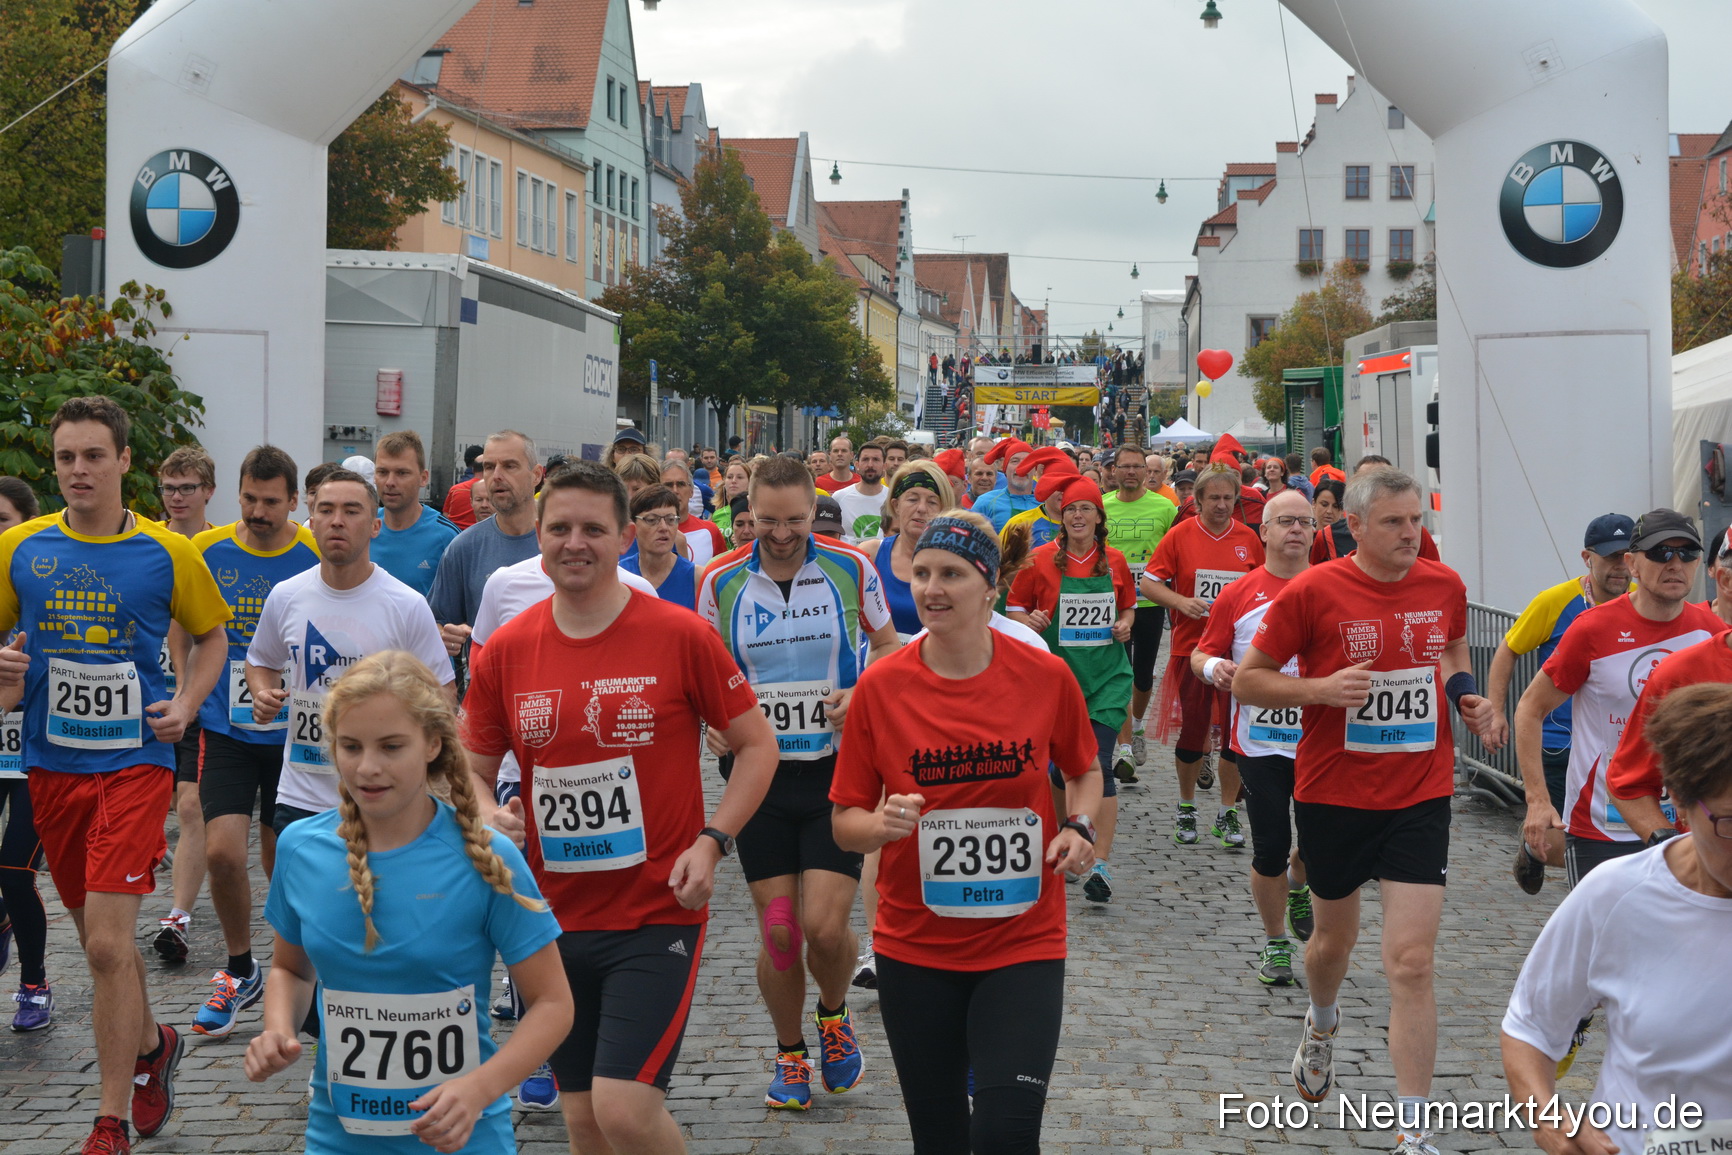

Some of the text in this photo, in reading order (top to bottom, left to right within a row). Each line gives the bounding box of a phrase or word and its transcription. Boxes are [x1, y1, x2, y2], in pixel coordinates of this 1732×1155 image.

[137, 151, 231, 193] BMW
[1510, 143, 1615, 188] BMW
[583, 353, 613, 398] BOCK
[1015, 390, 1058, 401] START
[930, 531, 977, 555] BALL
[873, 592, 884, 614] PLAST
[97, 615, 116, 623] 2014
[782, 605, 829, 620] PLAST
[1065, 605, 1112, 626] 2224
[1404, 610, 1443, 619] NEUMARKTER
[1404, 617, 1439, 625] STADTLAUF
[1075, 631, 1103, 640] Brigitte
[1346, 625, 1377, 635] IMMER
[1346, 632, 1379, 642] WIEDER
[746, 632, 832, 649] www.tr-plast.de
[1349, 639, 1378, 652] NEU
[42, 647, 127, 656] www.stadtlauf-neumarkt.de
[1350, 650, 1378, 660] MARKT
[50, 666, 125, 682] PARTL Neumarkt
[580, 676, 657, 689] 11. NEUMARKTER
[1383, 676, 1423, 687] Neumarkt
[592, 685, 645, 696] STADTLAUF
[755, 688, 818, 699] ARTL Neumarkt
[56, 681, 129, 717] 2591
[293, 698, 311, 709] PARTL
[520, 697, 552, 709] IMMER
[1356, 688, 1430, 722] 2043
[518, 706, 553, 718] WIEDER
[61, 721, 123, 738] Sebastian
[296, 711, 323, 742] 28
[519, 715, 550, 731] NEU
[616, 722, 655, 730] 19.09.2010
[521, 729, 551, 740] MARKT
[1267, 729, 1298, 743] Jürgen
[1380, 729, 1406, 742] Fritz
[777, 738, 810, 750] Martin
[303, 749, 328, 763] Chris
[918, 759, 1018, 782] RUN FOR BÜRNI
[534, 772, 614, 788] PARTL Neumarkt
[538, 785, 632, 832] 2394
[921, 816, 1021, 831] PARTL Neumarkt
[563, 839, 614, 858] Patrick
[932, 831, 1032, 877] 2393
[962, 886, 1005, 903] Petra
[327, 1003, 452, 1022] PARTL Neumarkt
[340, 1024, 465, 1081] 2760
[1016, 1074, 1046, 1087] CRAFT
[1647, 1139, 1707, 1155] PARTL
